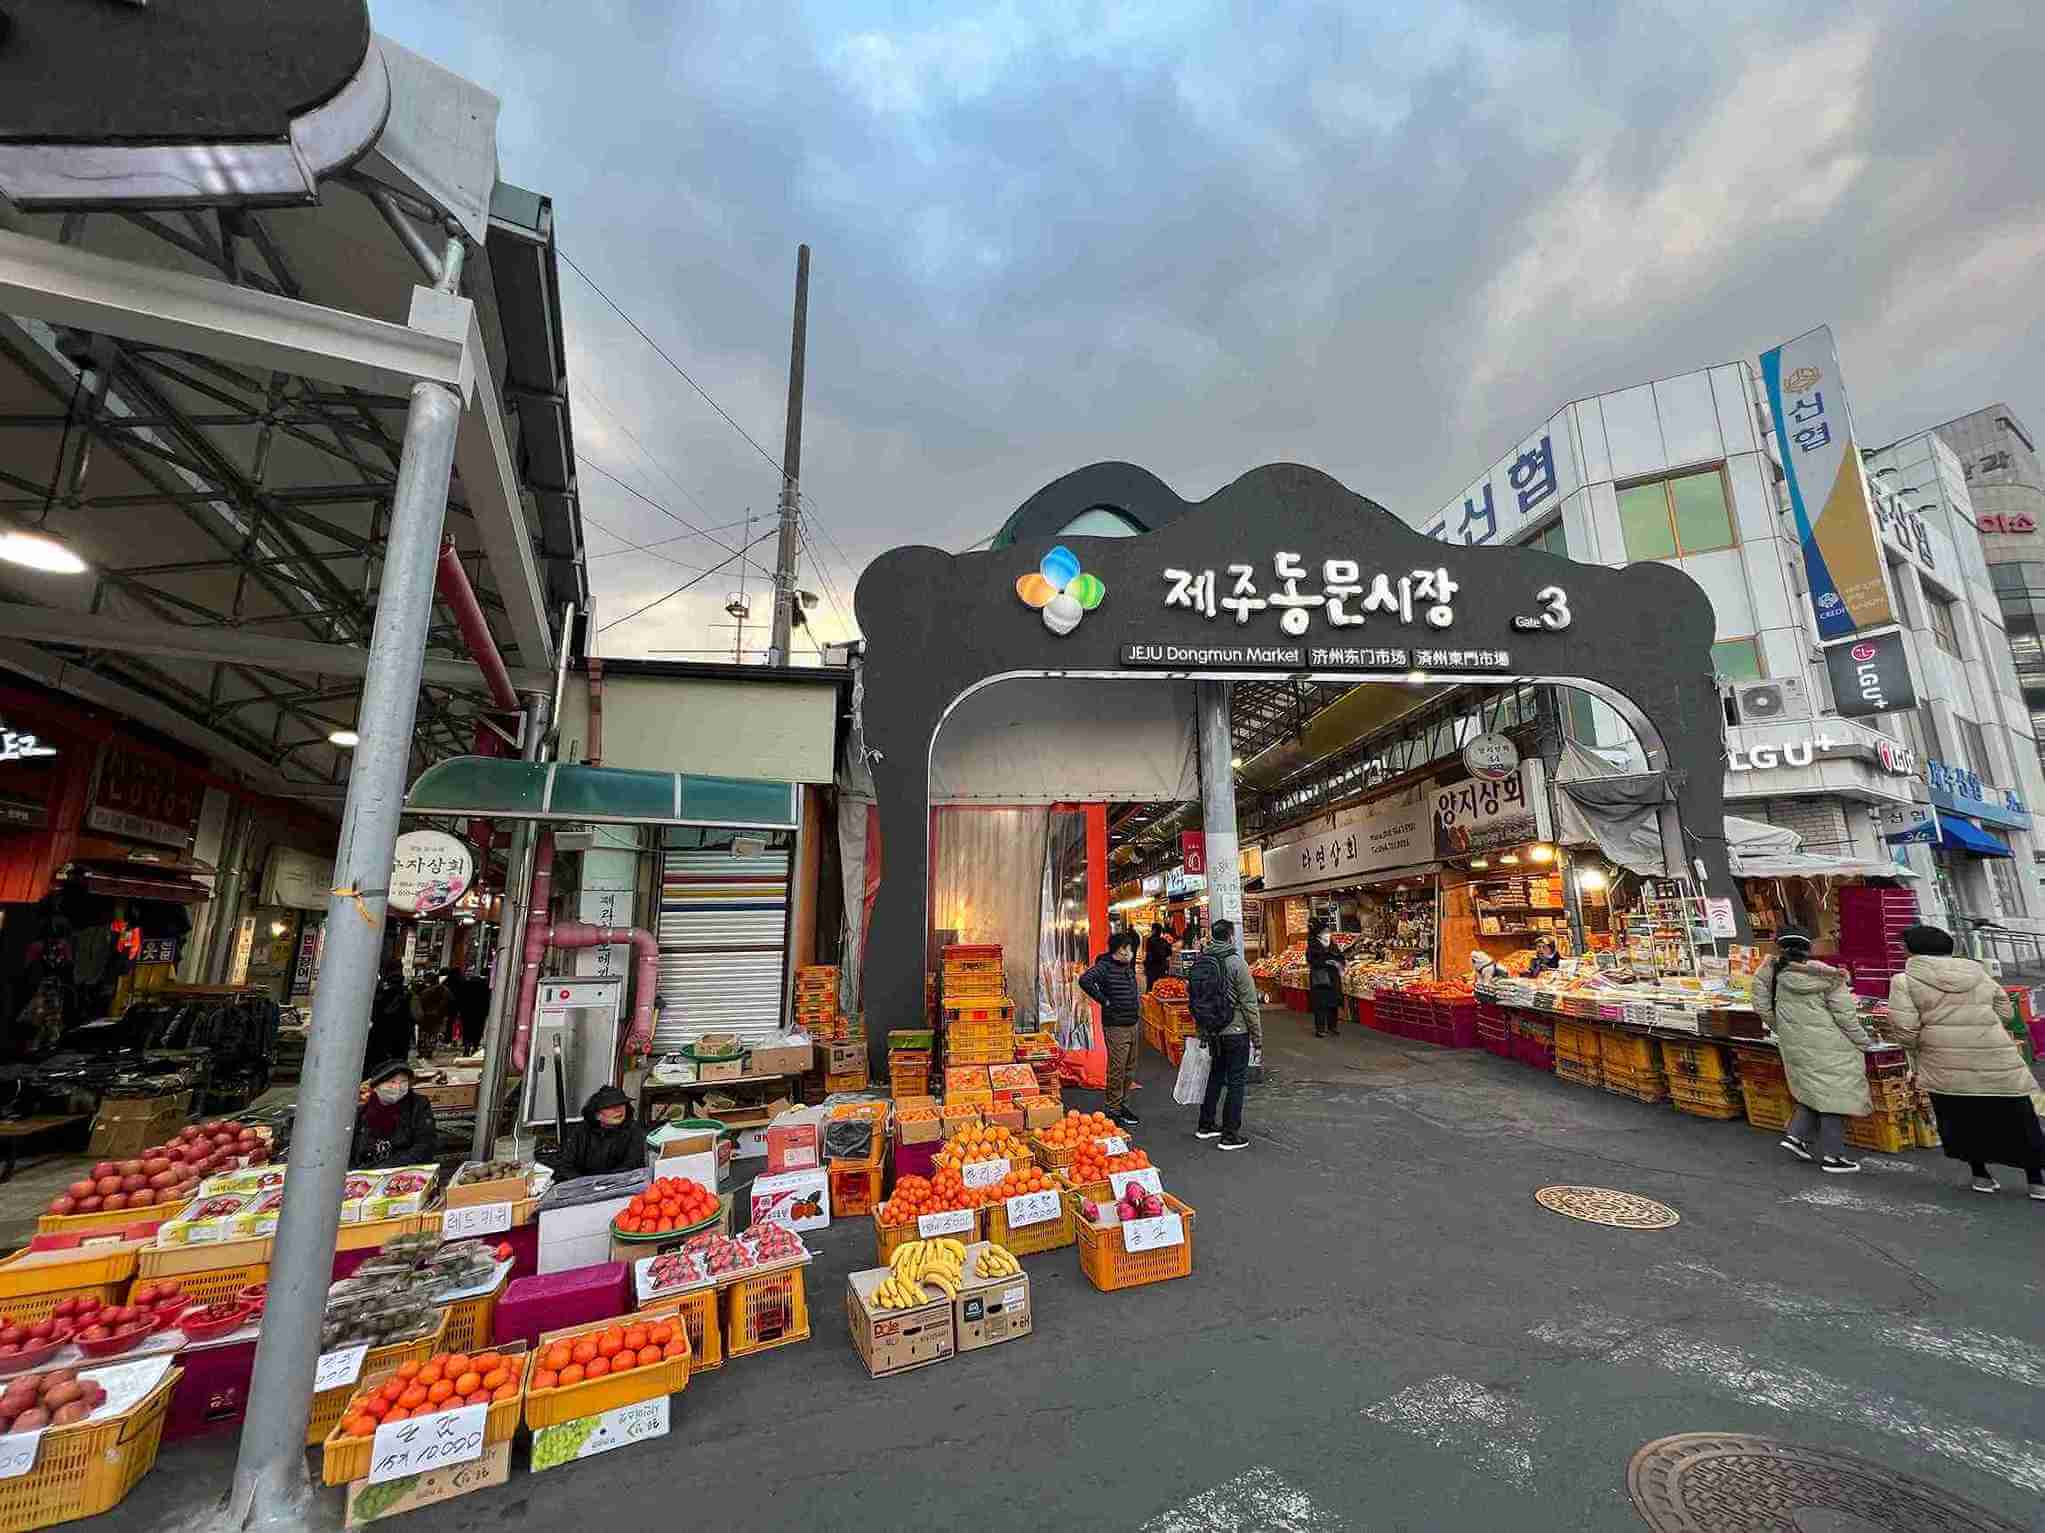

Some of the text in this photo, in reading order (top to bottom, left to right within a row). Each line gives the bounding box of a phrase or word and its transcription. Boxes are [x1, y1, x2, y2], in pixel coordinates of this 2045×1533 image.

[1788, 392, 1831, 454] 신협
[1163, 551, 1458, 636] 제주동문시장
[1536, 586, 1571, 630] 3
[1128, 645, 1299, 664] JEJU Dongmun Market
[1857, 663, 1888, 709] LGU+
[1728, 733, 1835, 771] LGU+
[1438, 768, 1526, 826] 양지상회
[874, 1321, 897, 1337] Dole
